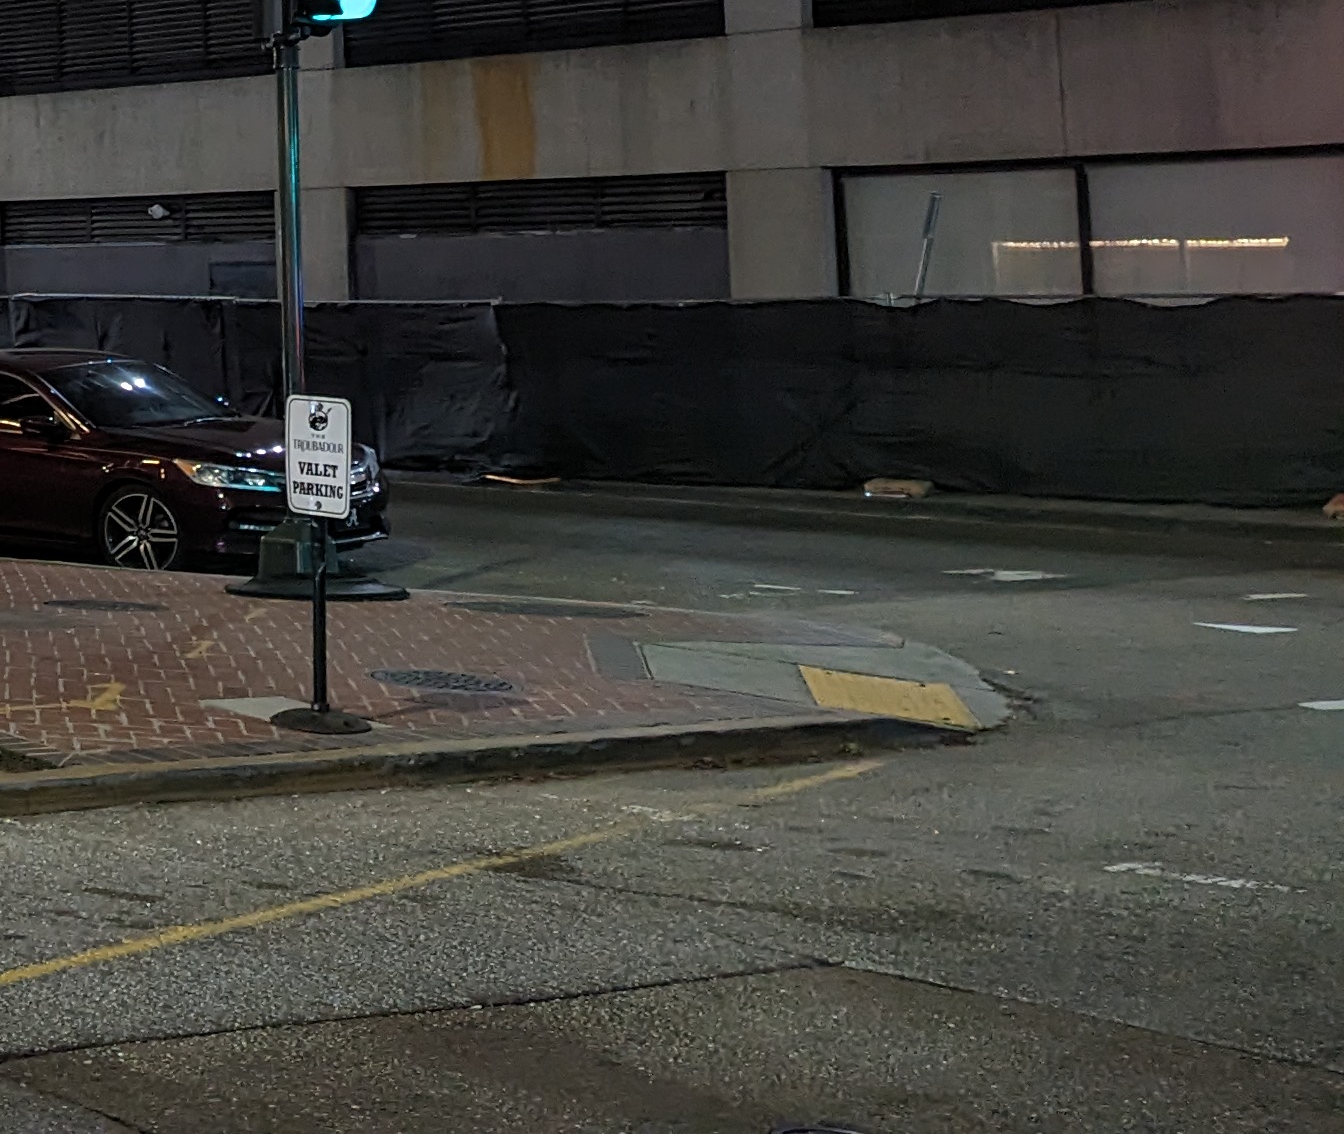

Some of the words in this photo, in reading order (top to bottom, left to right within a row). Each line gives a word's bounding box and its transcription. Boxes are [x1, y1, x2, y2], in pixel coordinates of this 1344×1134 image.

[293, 439, 344, 454] TROUBADOUR
[298, 461, 339, 478] VALET
[292, 480, 344, 499] PARKING
